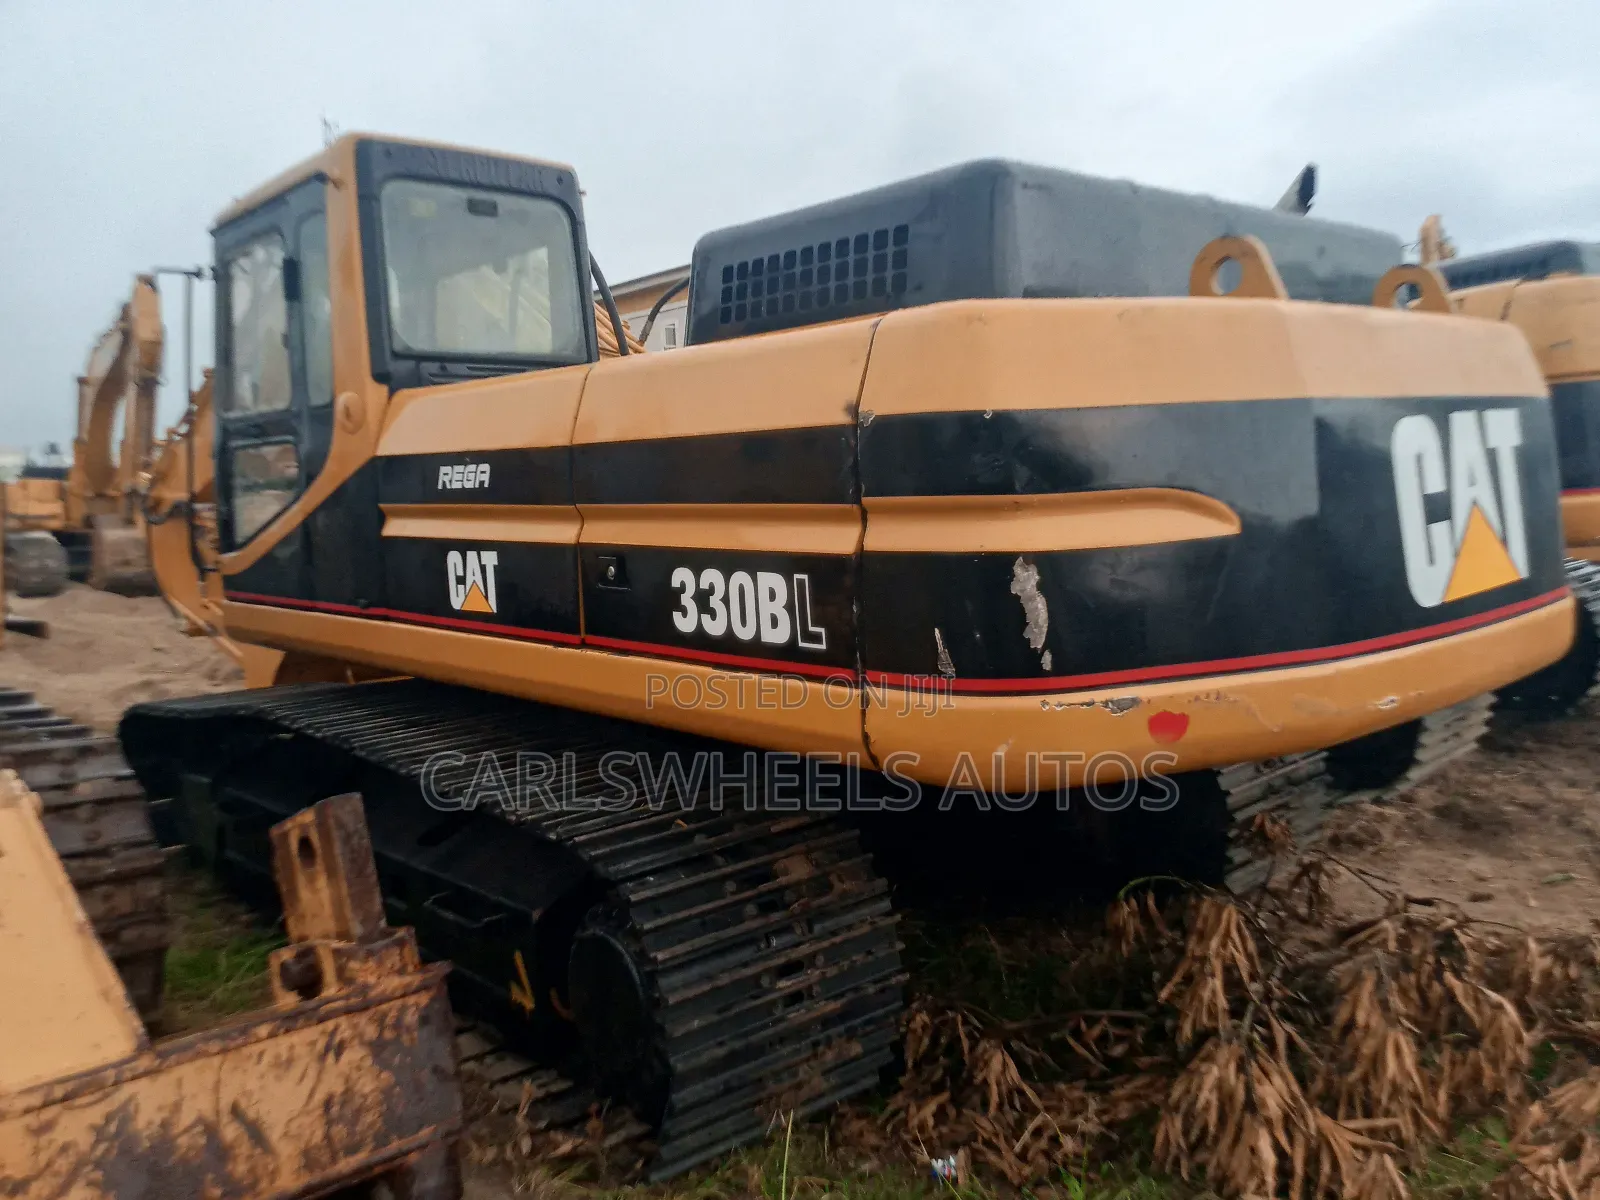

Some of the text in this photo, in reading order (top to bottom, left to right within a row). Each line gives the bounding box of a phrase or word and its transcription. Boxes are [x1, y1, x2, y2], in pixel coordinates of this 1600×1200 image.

[437, 463, 491, 490] REGA
[1391, 408, 1530, 608] CAT
[446, 550, 498, 613] CAT
